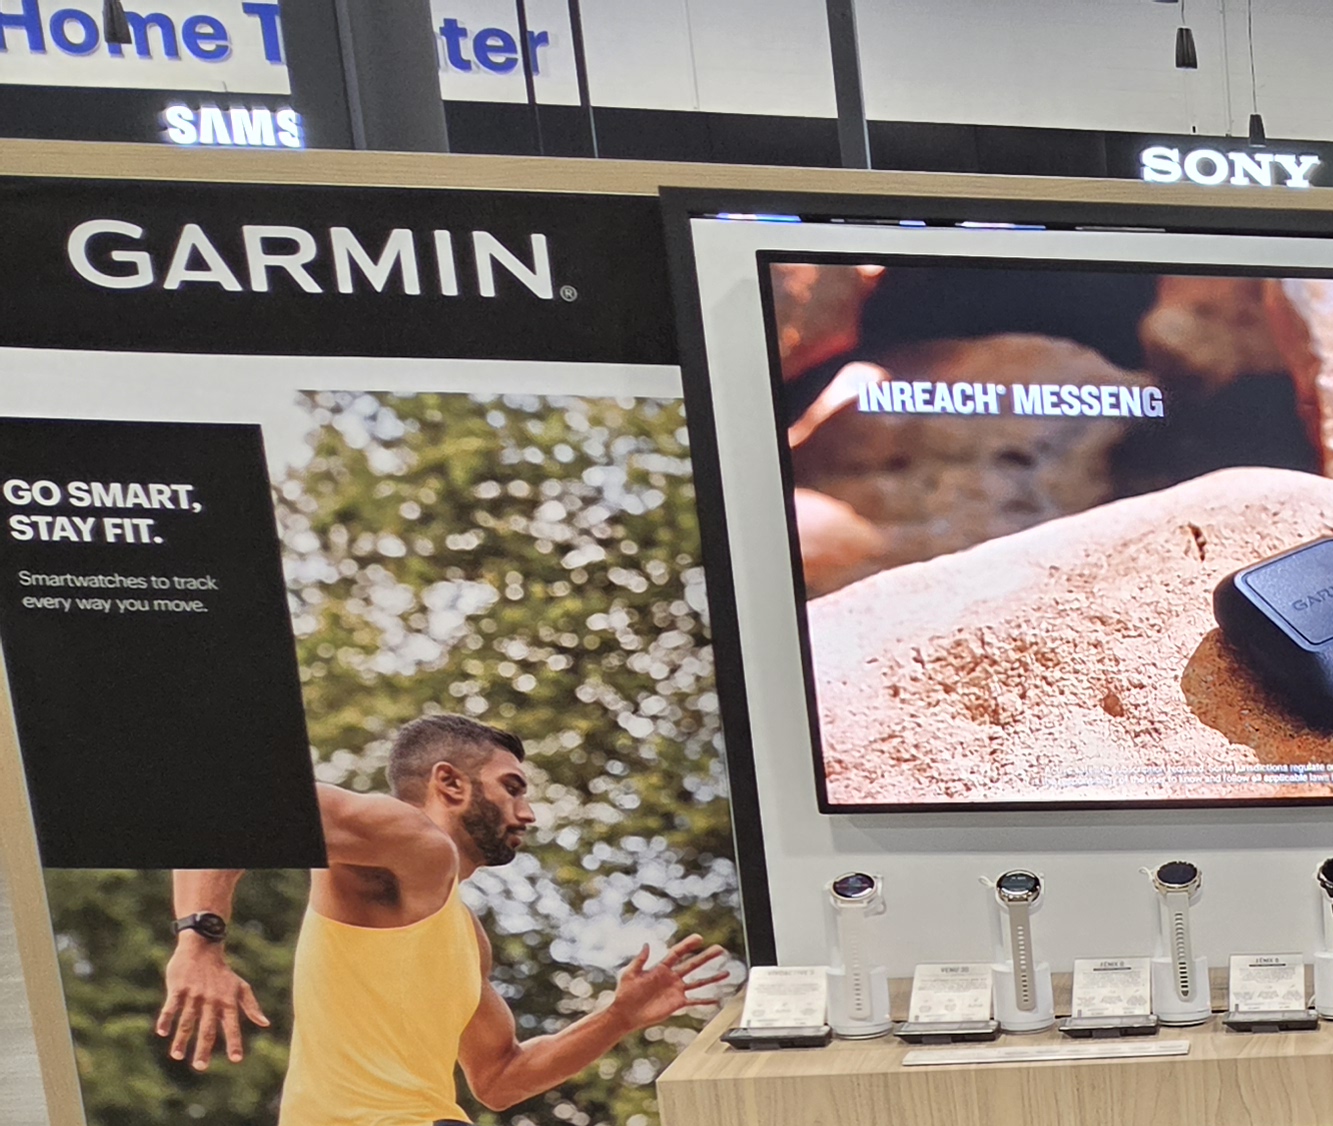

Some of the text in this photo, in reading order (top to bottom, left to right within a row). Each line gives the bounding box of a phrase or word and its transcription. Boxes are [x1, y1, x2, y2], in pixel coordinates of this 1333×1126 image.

[0, 0, 549, 75] Home Tter
[164, 104, 303, 148] SAMS
[1139, 146, 1320, 188] SONY
[1011, 384, 1164, 417] MESSENG
[3, 479, 202, 513] GO SMART,
[9, 515, 163, 543] STAY FIT.
[18, 570, 218, 590] Smartwatches to track
[22, 596, 208, 613] every way you move.
